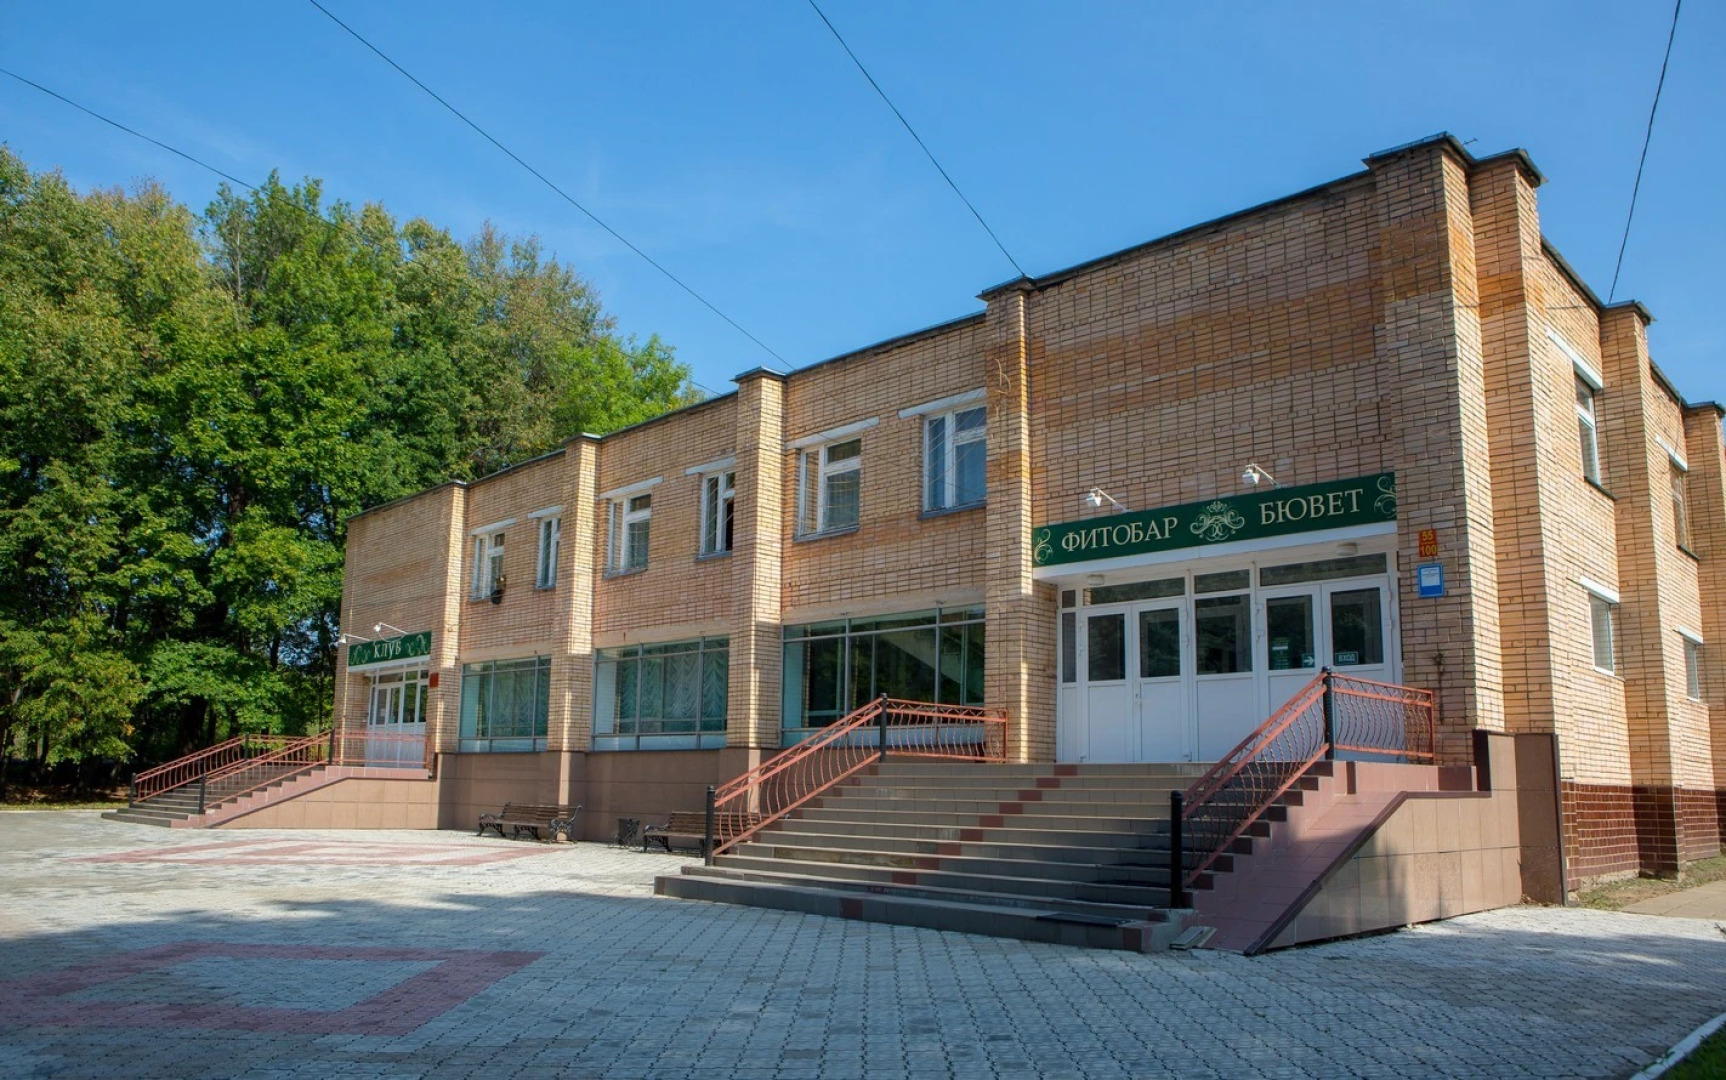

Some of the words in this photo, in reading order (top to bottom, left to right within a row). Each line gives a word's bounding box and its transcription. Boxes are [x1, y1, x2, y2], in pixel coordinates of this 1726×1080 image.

[1061, 517, 1178, 552] ФИТОБАР
[1259, 488, 1363, 525] БЮВЕТ
[1422, 530, 1433, 541] 55
[1420, 544, 1437, 556] 100
[373, 641, 402, 659] КЛУБ
